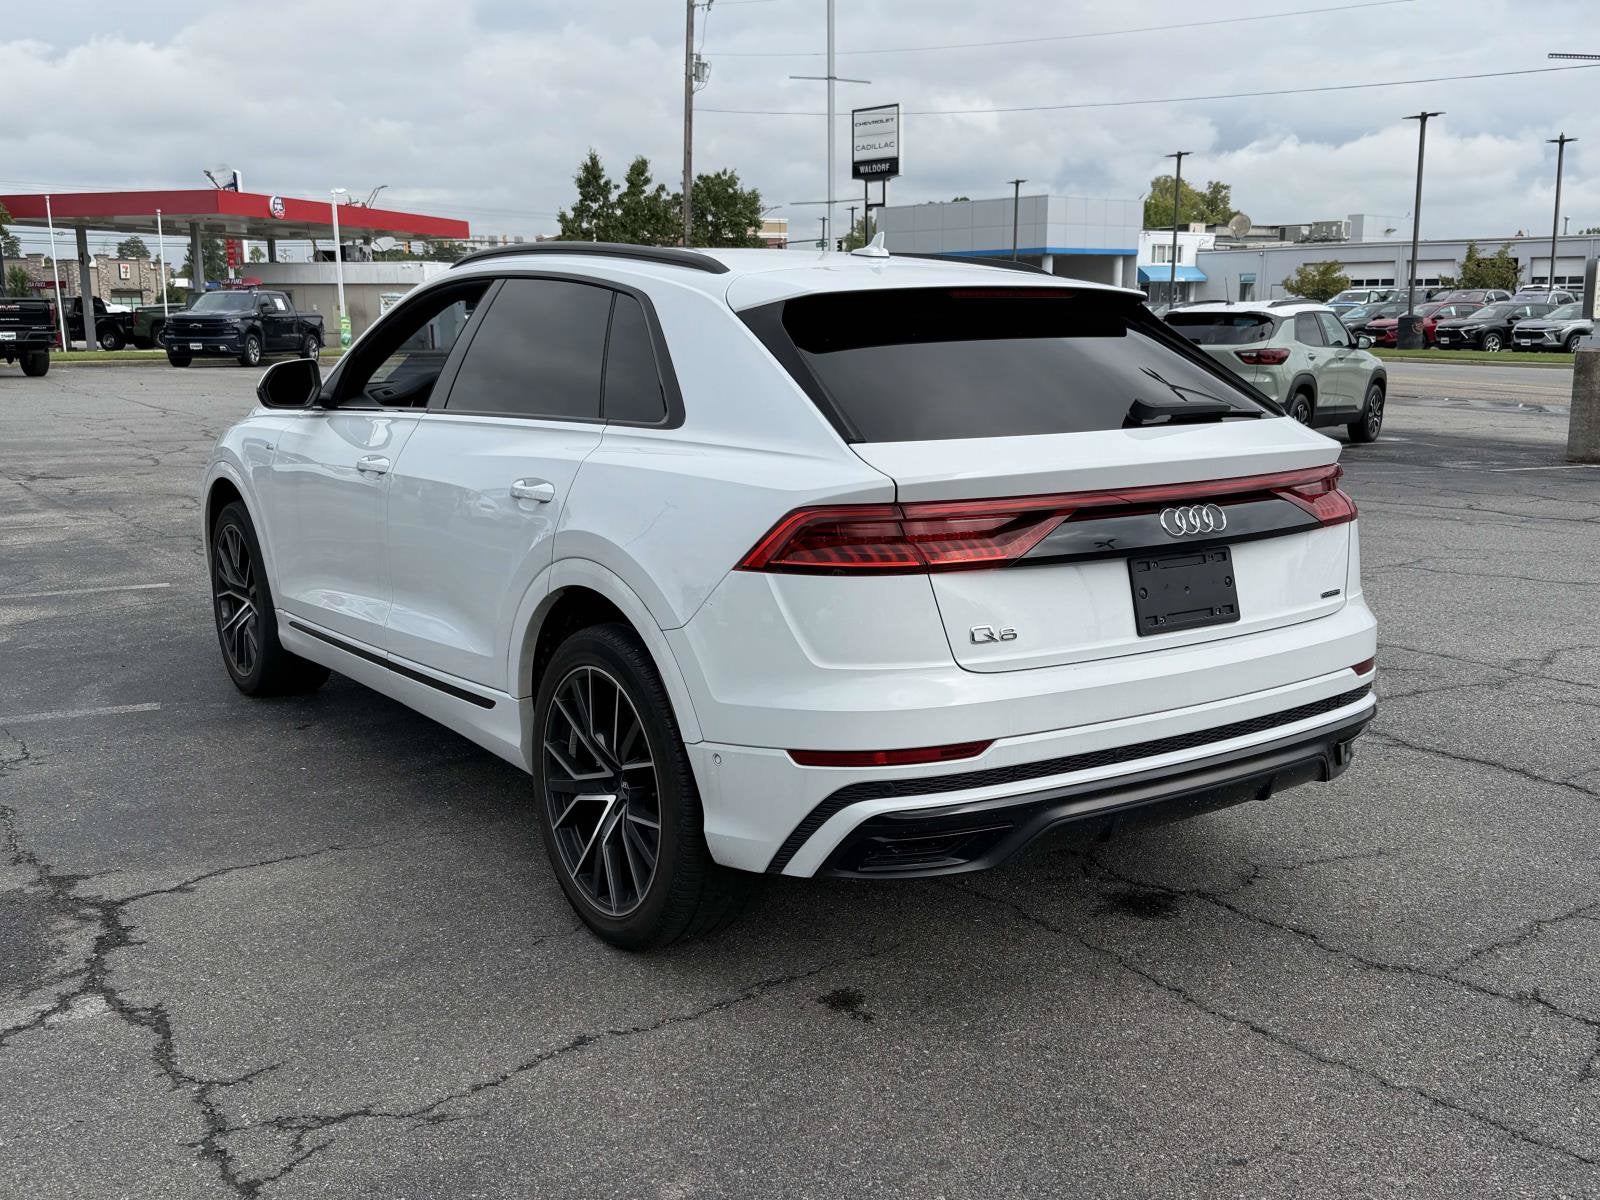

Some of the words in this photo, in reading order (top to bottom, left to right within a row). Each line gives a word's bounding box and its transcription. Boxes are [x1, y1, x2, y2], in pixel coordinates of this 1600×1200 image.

[855, 117, 895, 128] CHEVROLET
[855, 141, 895, 152] CADILLAC
[859, 163, 890, 174] WALDORF
[969, 624, 1018, 645] Q8
